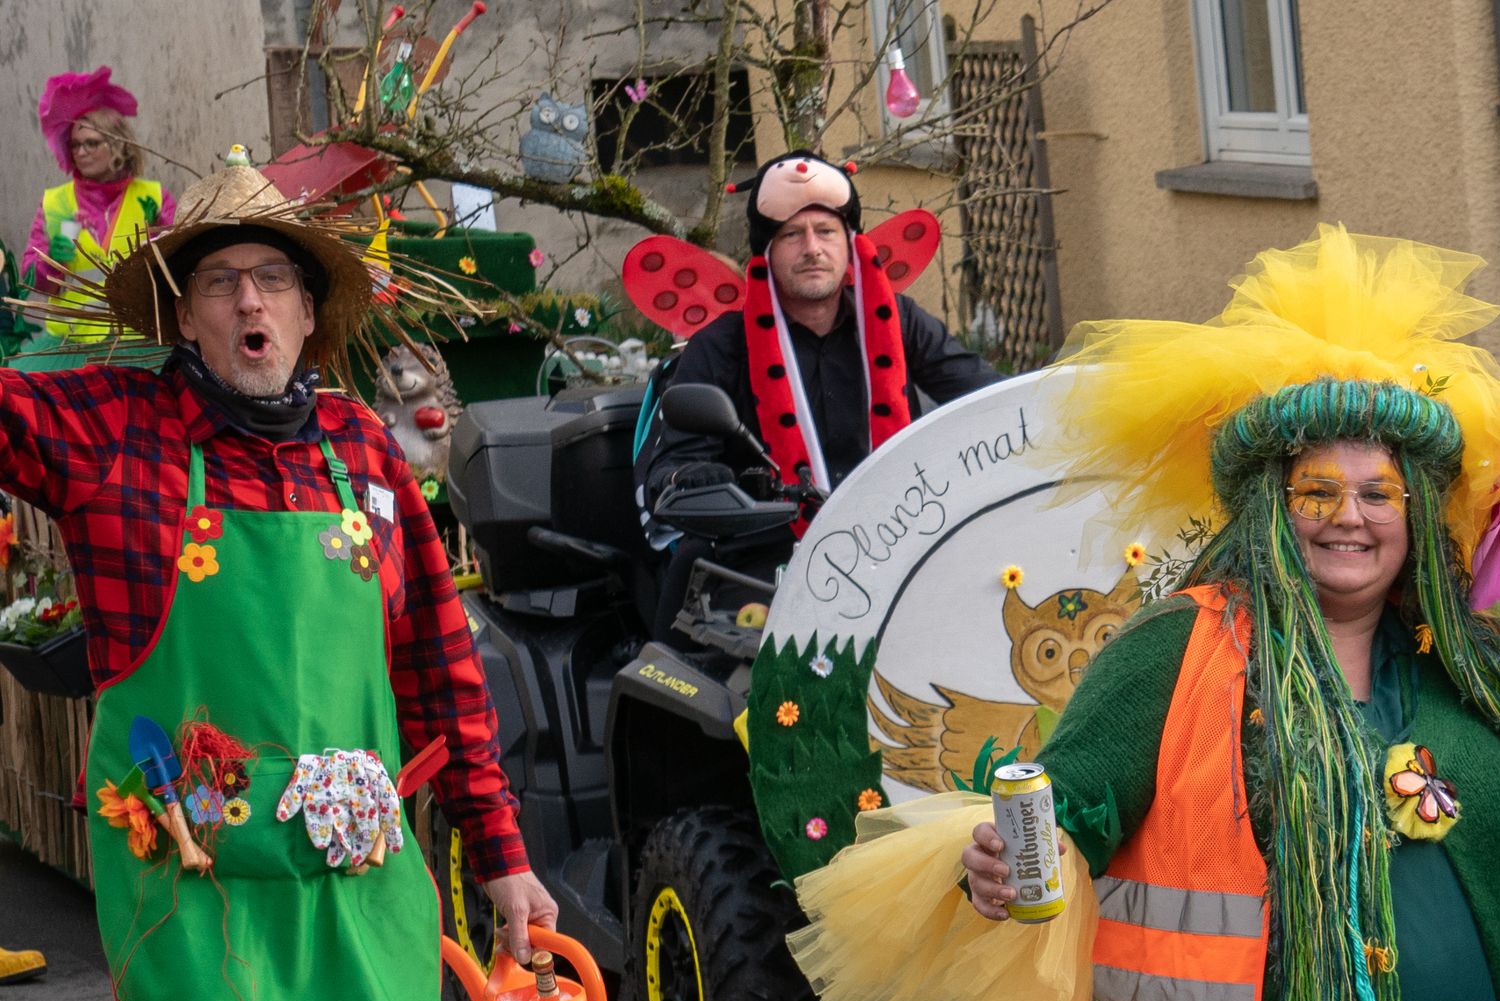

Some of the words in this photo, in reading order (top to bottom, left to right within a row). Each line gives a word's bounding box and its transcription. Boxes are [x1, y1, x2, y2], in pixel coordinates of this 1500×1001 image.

[958, 407, 1036, 476] mat
[638, 663, 699, 698] OUTLANDER
[1042, 820, 1055, 870] Radler
